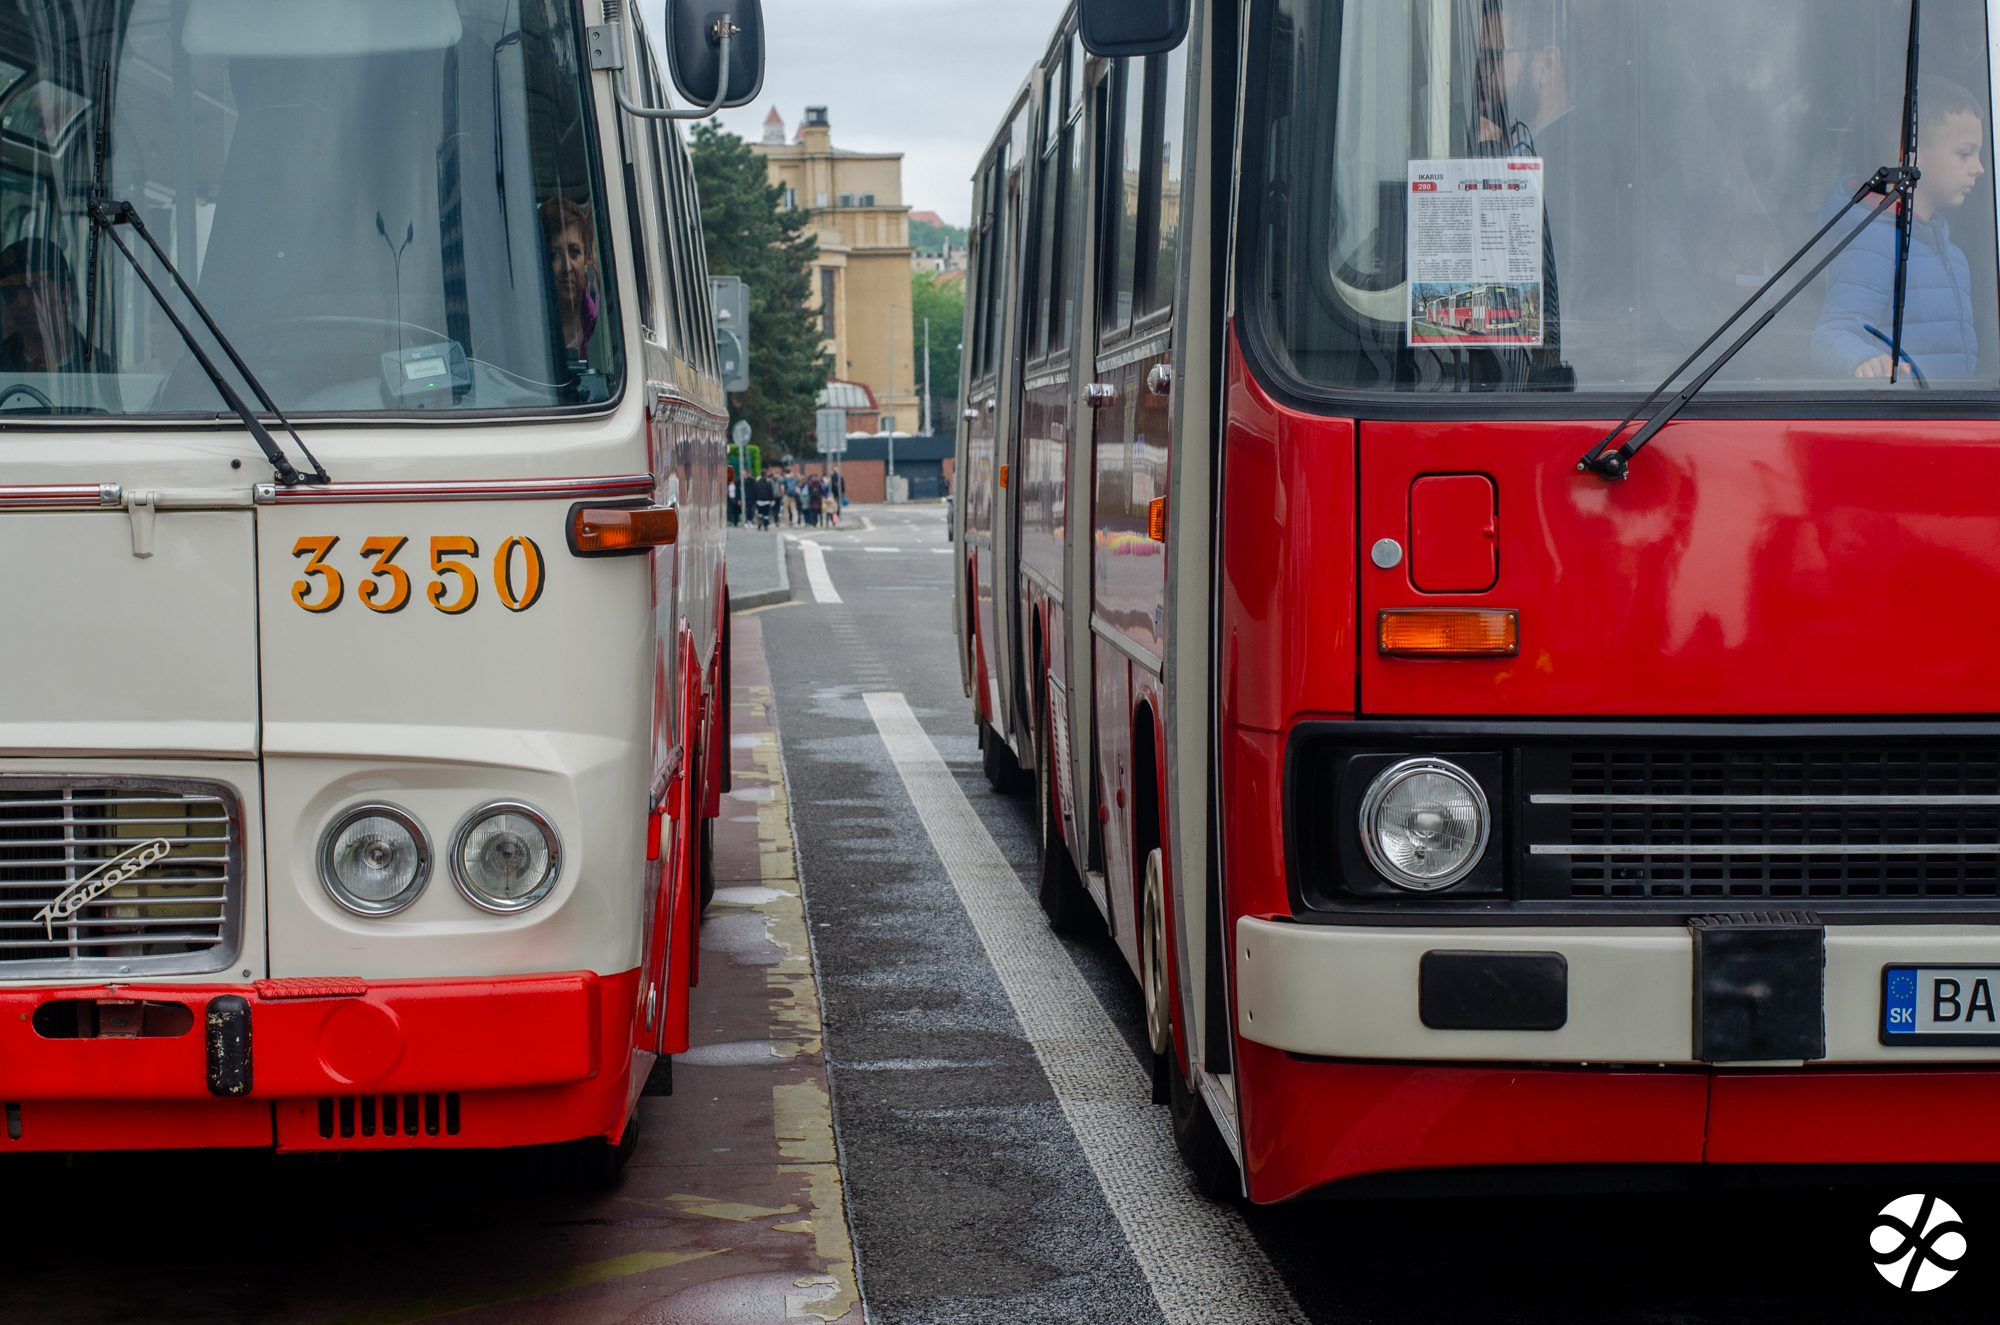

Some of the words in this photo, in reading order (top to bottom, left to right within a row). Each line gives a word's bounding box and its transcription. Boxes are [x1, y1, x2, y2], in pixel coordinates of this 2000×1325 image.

[291, 535, 545, 615] 3350
[32, 837, 171, 941] Karosa
[1890, 1007, 1913, 1023] SK
[1933, 978, 1995, 1022] BA
